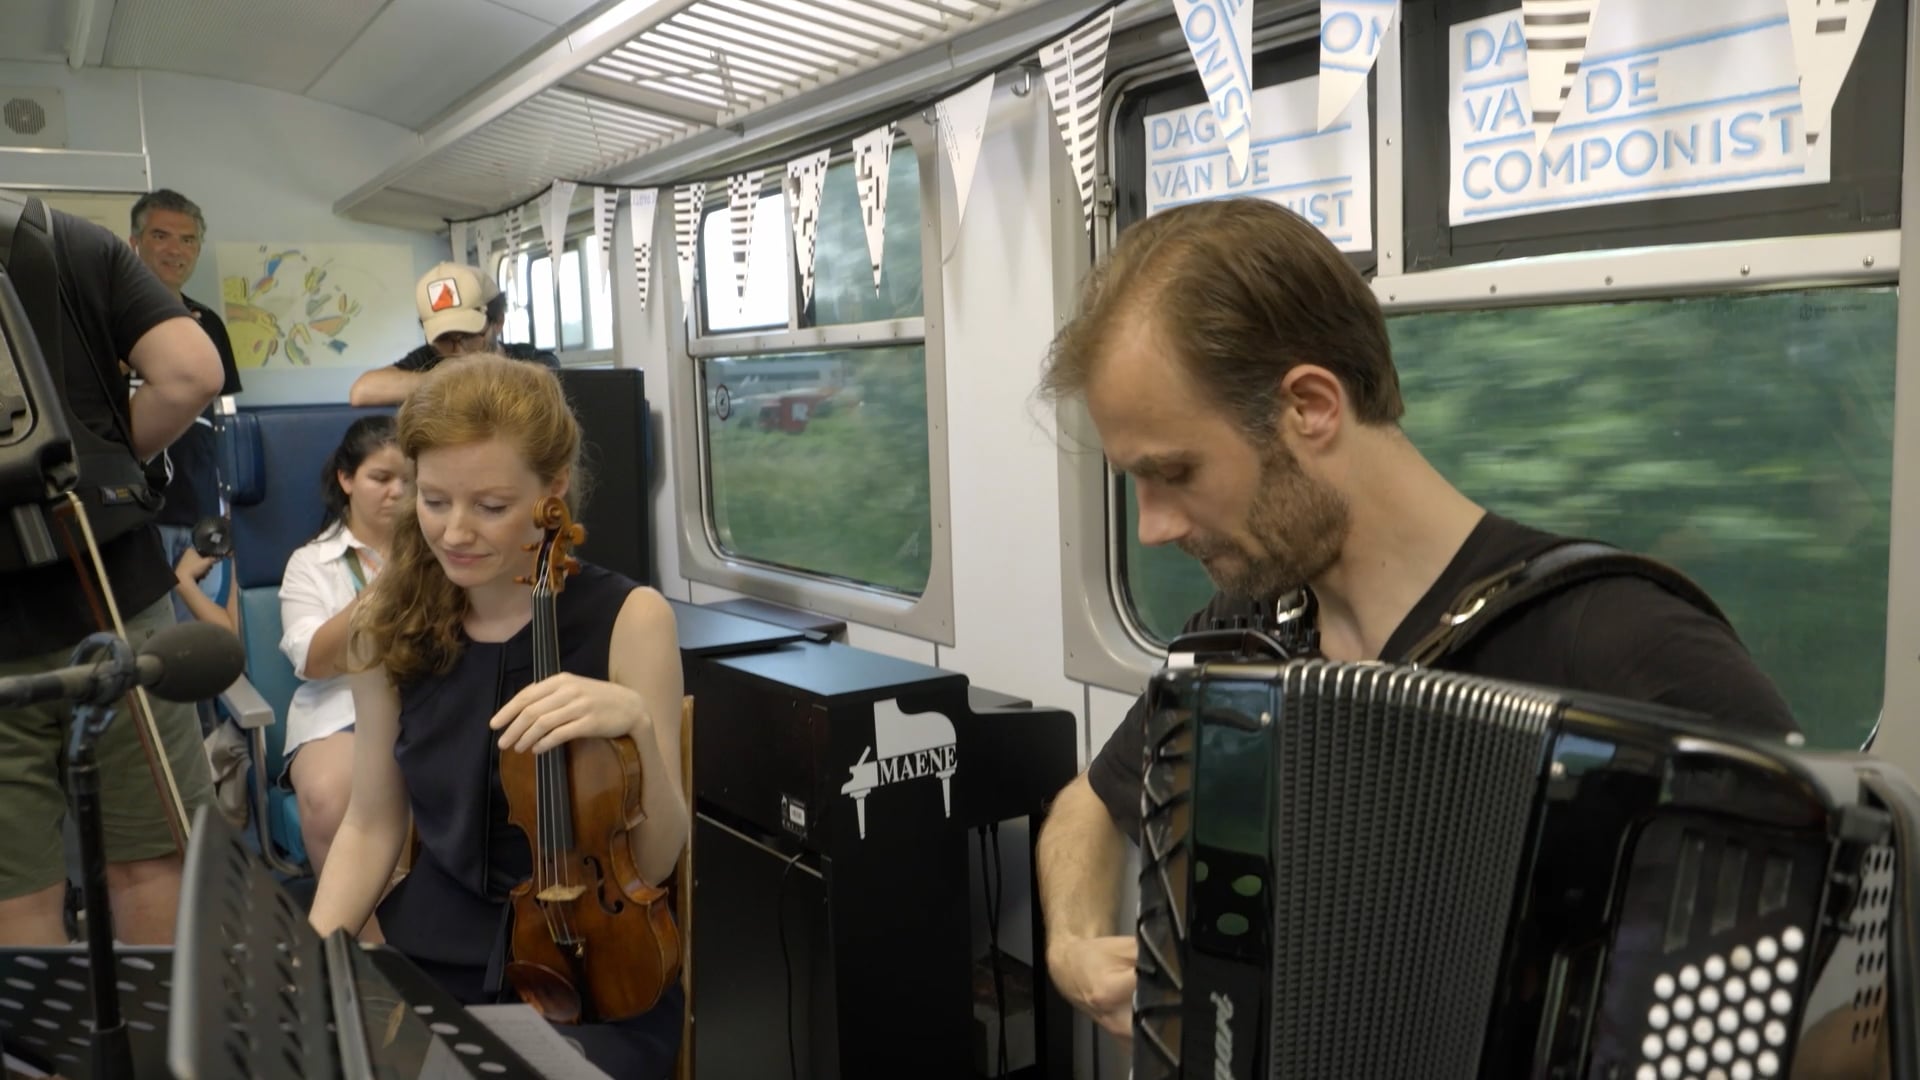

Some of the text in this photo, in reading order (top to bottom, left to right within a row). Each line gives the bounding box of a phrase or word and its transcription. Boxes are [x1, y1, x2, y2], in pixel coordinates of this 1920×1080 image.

[1464, 19, 1528, 73] DA
[1464, 57, 1660, 132] VA DE
[1152, 109, 1216, 151] DAG
[1463, 103, 1803, 200] COMPONIST
[1153, 149, 1270, 197] VAN DE
[879, 744, 958, 787] MAENE
